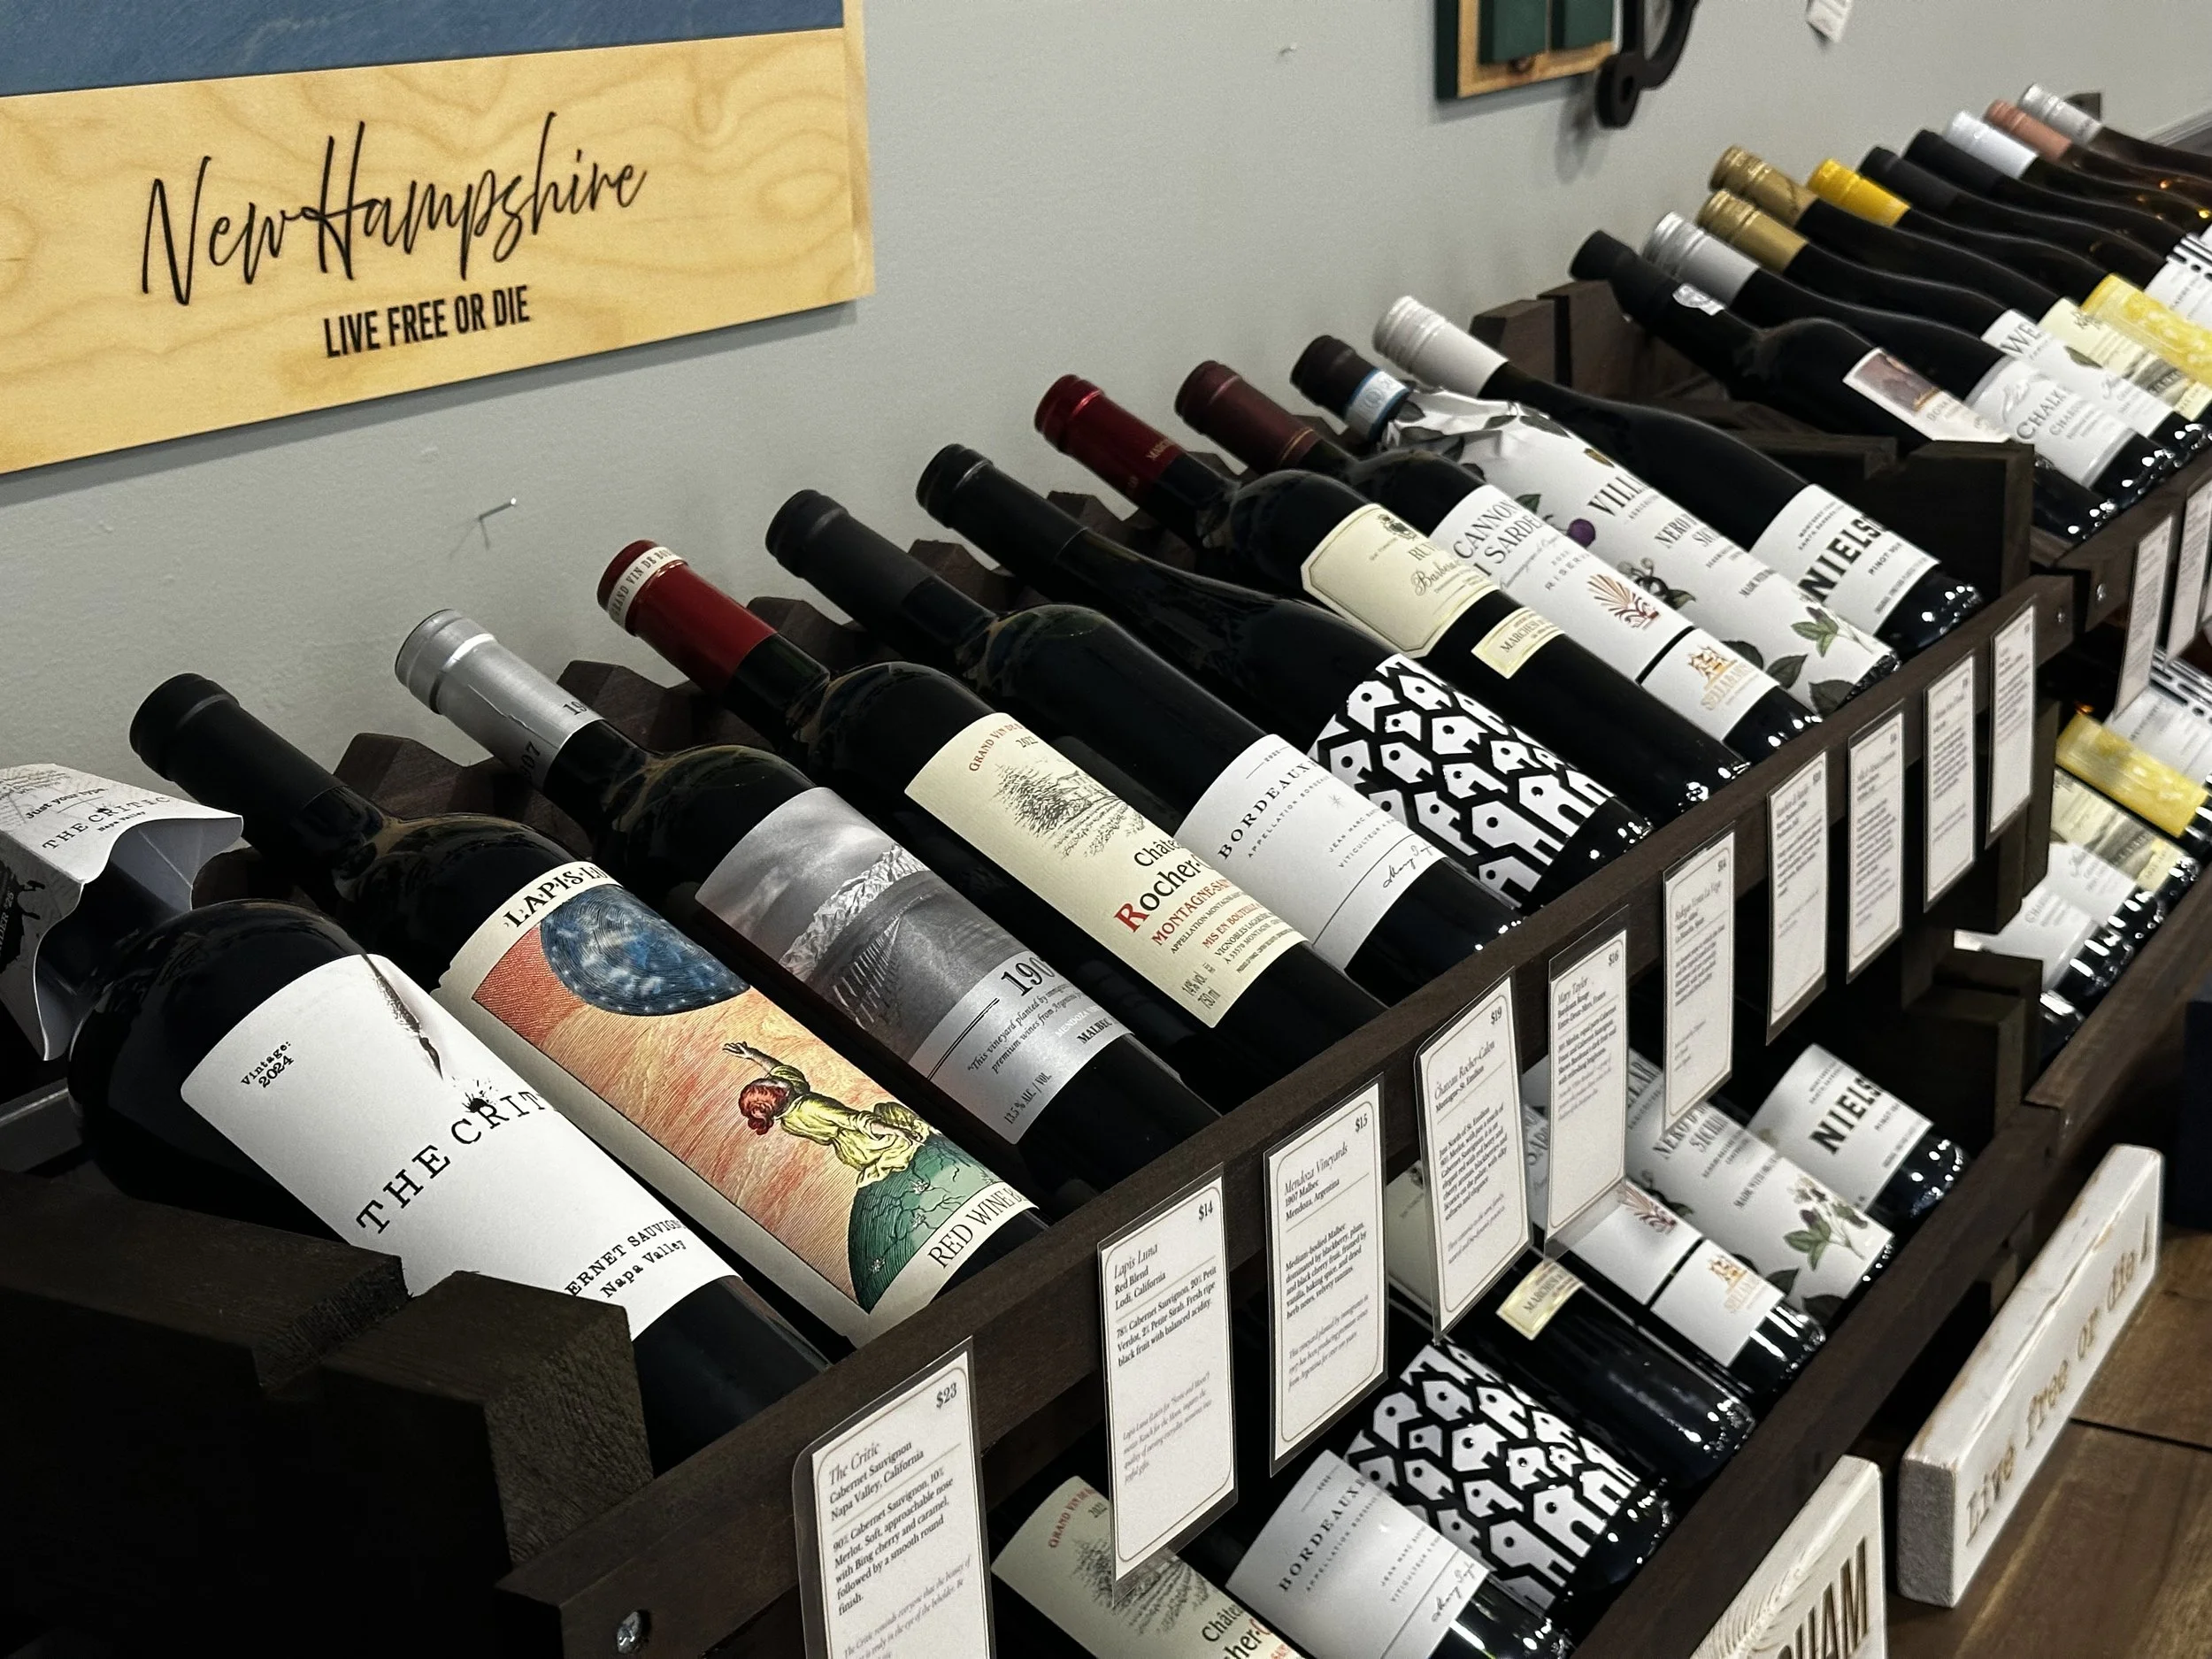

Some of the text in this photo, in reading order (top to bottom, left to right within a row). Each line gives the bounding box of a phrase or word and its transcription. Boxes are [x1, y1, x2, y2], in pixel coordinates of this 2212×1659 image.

[142, 112, 648, 305] New Hampshire
[324, 285, 531, 358] LIVE FREE OR DIE
[2001, 321, 2042, 355] WE
[1147, 441, 1175, 462] MARC
[1453, 500, 1520, 560] CANNON
[626, 566, 644, 585] VIN
[641, 556, 657, 569] DE
[1473, 562, 1493, 578] I
[1546, 552, 1591, 591] RISERV
[1797, 513, 1892, 605] NIELS
[563, 700, 591, 718] 19
[968, 727, 1008, 772] GRAND VIN
[25, 803, 52, 819] Just
[51, 792, 79, 805] your
[42, 796, 171, 849] THE CRITIC
[1217, 763, 1311, 861] BORDEAUX
[1248, 800, 1298, 859] APPELLATION
[1329, 833, 1347, 853] JEAN
[1348, 817, 1366, 833] MARC
[1337, 827, 1381, 868] VITICULTEUR
[503, 870, 584, 928] LAPIS
[1170, 914, 1209, 955] APPELLATION
[1201, 931, 1219, 949] MIS
[1216, 922, 1229, 935] EN
[1214, 926, 1249, 958] VIGNOBLES
[1000, 956, 1056, 997] 190
[987, 995, 1048, 1056] vineyard planted by
[991, 1007, 1055, 1075] premium wines from
[1054, 1010, 1091, 1039] MENDOZA
[1076, 1017, 1114, 1045] MALBEC
[239, 1039, 292, 1088] Vintage:
[257, 1053, 296, 1089] 2024
[1355, 1112, 1367, 1133] $15
[1809, 1076, 1883, 1156] NIELS
[355, 1089, 559, 1236] THE CRIT
[1284, 1141, 1348, 1195] Mendoza Vineyards
[1198, 1200, 1213, 1221] $14
[1285, 1179, 1318, 1207] 1907 Malbec
[1313, 1179, 1340, 1202] Argentina
[926, 1190, 1016, 1269] RED WINE
[1285, 1223, 1345, 1271] Medium-bodied Malbec
[565, 1218, 687, 1297] ERNET SAUVIG
[599, 1230, 687, 1299] Napa Valley
[1114, 1243, 1157, 1286] Lapis Luna
[1114, 1264, 1148, 1295] Red Blend
[1286, 1231, 1366, 1296] and black cherry framed by
[1286, 1252, 1322, 1283] dominated by
[1305, 1244, 1361, 1293] baking and dried
[1128, 1306, 1156, 1330] Cabernet
[1202, 1266, 1216, 1280] Petit
[1133, 1272, 1165, 1297] California
[1150, 1314, 1167, 1331] Petite
[1186, 1287, 1202, 1306] Fresh
[1202, 1281, 1215, 1294] ripe
[1286, 1279, 1333, 1319] herb velvety
[1118, 1310, 1190, 1367] black fruit with balanced
[936, 1382, 956, 1409] $23
[1965, 1443, 2016, 1547] Live
[2024, 1358, 2070, 1450] free
[2076, 1307, 2101, 1362] or
[828, 1442, 879, 1485] The Critic
[829, 1441, 911, 1503] Cabernet Sauvignon
[831, 1450, 924, 1521] Napa Valley, California
[850, 1509, 886, 1540] Cabernet
[884, 1478, 953, 1532] approachable nose
[835, 1564, 853, 1583] with
[855, 1551, 873, 1570] Bing
[874, 1532, 900, 1555] cherry
[901, 1517, 916, 1536] and
[1048, 1511, 1071, 1549] GRAND
[1278, 1486, 1360, 1593] BORDEAUX
[837, 1513, 943, 1600] followed by a smooth round
[838, 1593, 863, 1616] finish.
